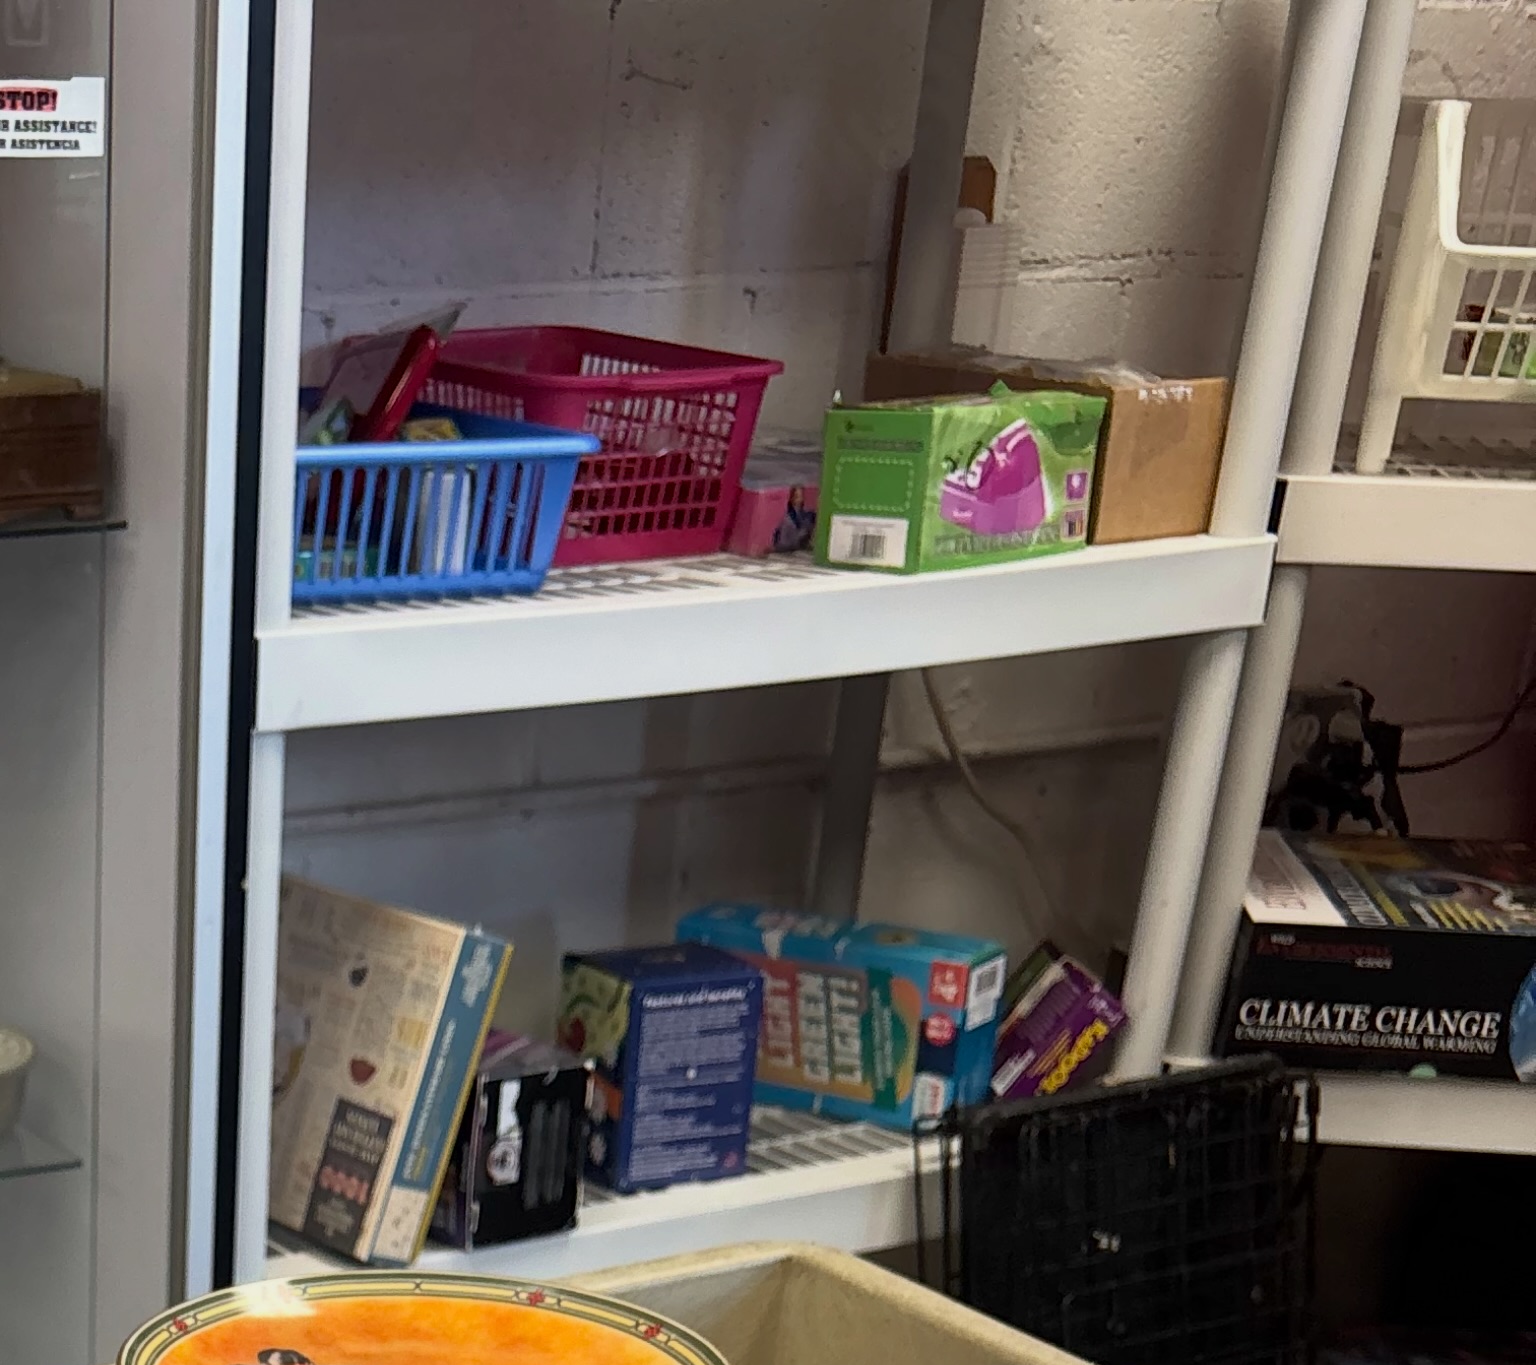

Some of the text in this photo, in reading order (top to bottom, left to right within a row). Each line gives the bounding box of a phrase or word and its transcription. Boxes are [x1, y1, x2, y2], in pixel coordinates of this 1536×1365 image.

[15, 119, 98, 134] ASSISTANCE!
[10, 139, 81, 151] ASISTENCIA
[1239, 998, 1502, 1040] CLIMATE CHANGE
[1235, 1024, 1497, 1054] UNDERSTANDING GLOBAL WARMING
